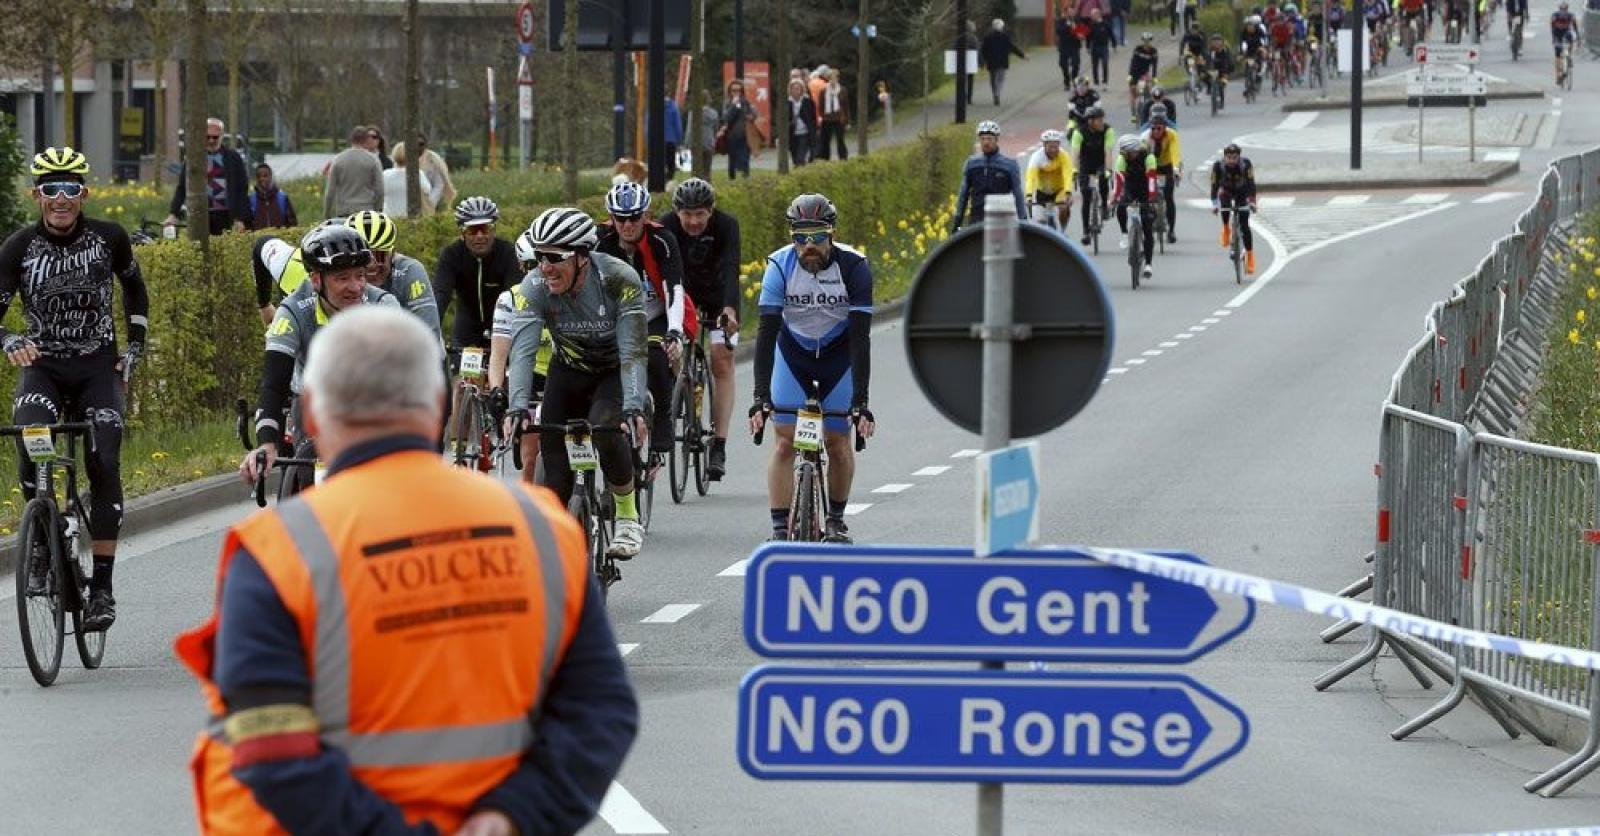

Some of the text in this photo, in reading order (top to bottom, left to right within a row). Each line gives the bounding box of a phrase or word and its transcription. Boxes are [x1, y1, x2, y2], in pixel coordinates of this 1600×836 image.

[368, 546, 523, 593] VOLCKE
[785, 575, 1151, 636] N60 Gent
[767, 696, 1193, 757] N60 Ronse
